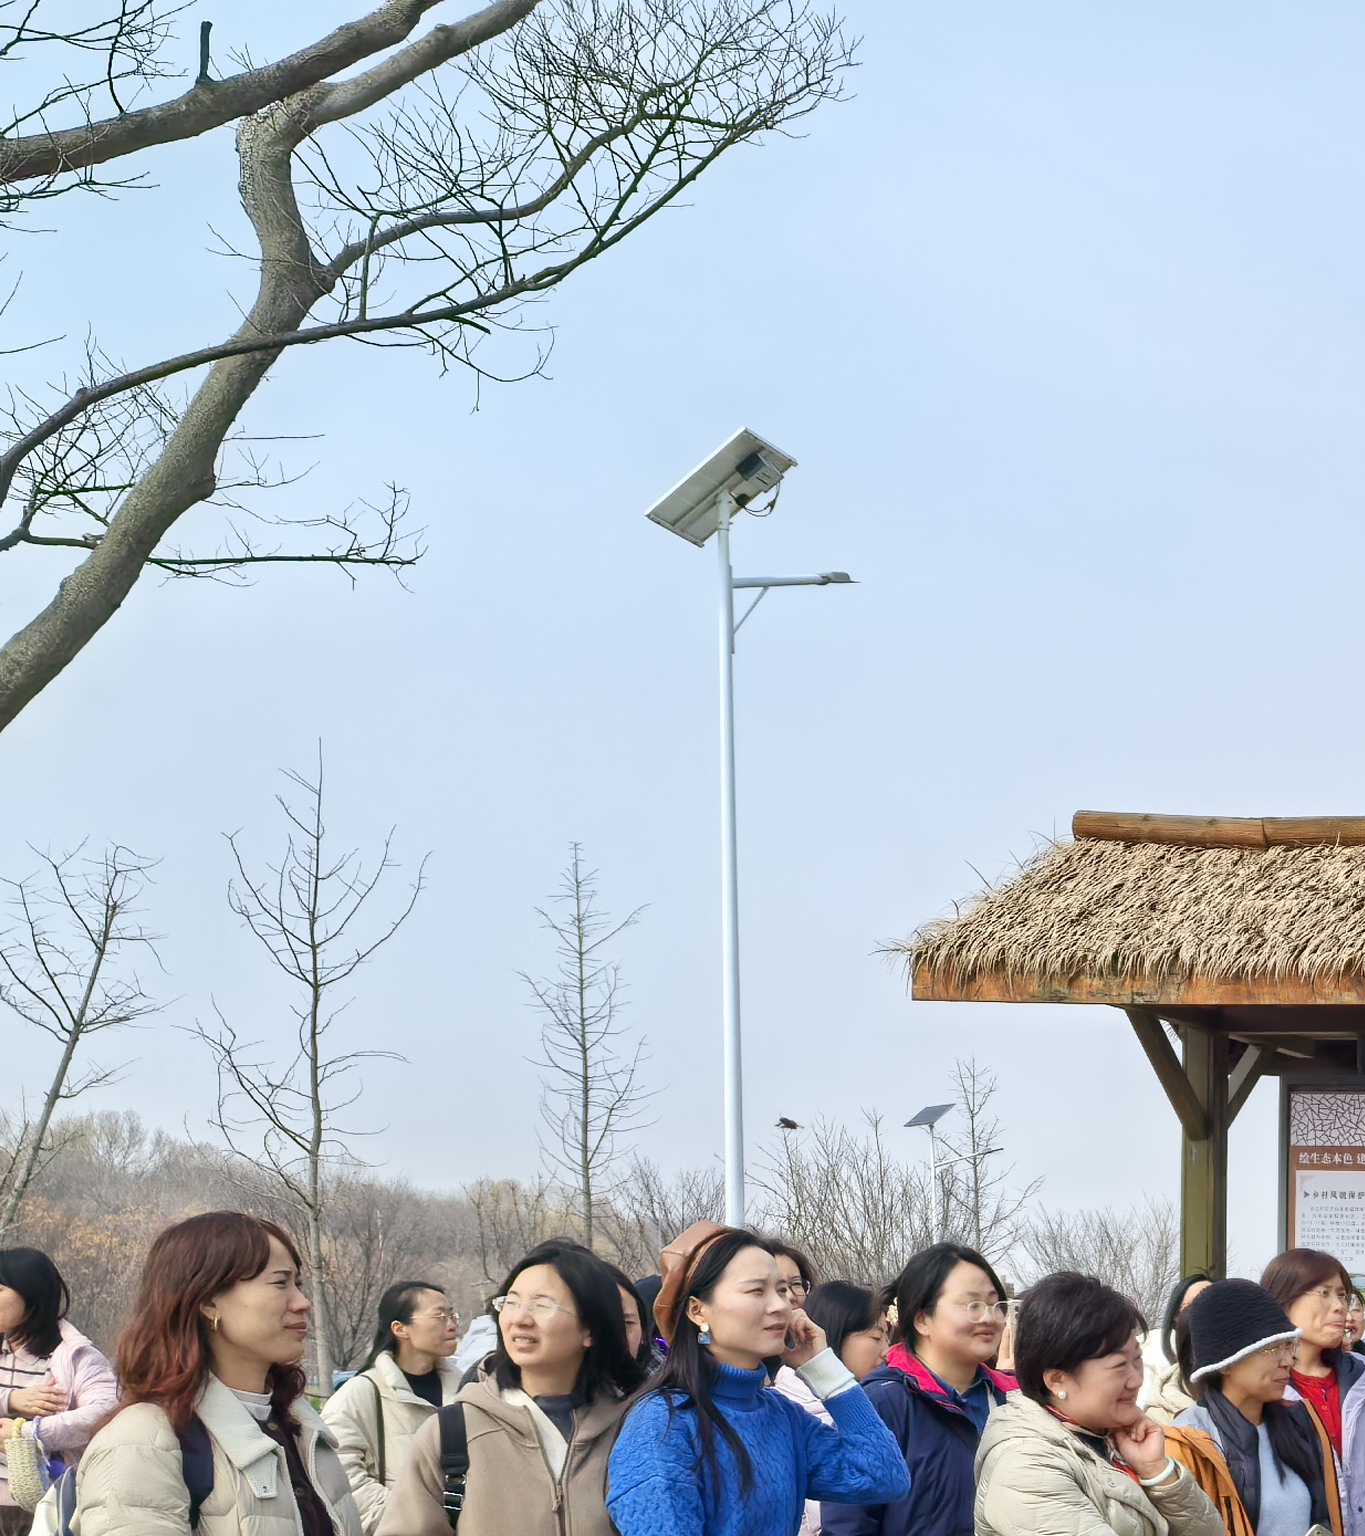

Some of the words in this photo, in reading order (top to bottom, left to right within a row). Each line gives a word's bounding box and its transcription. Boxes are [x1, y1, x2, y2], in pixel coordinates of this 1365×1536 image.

[1298, 1152, 1353, 1165] 绘生态本色
